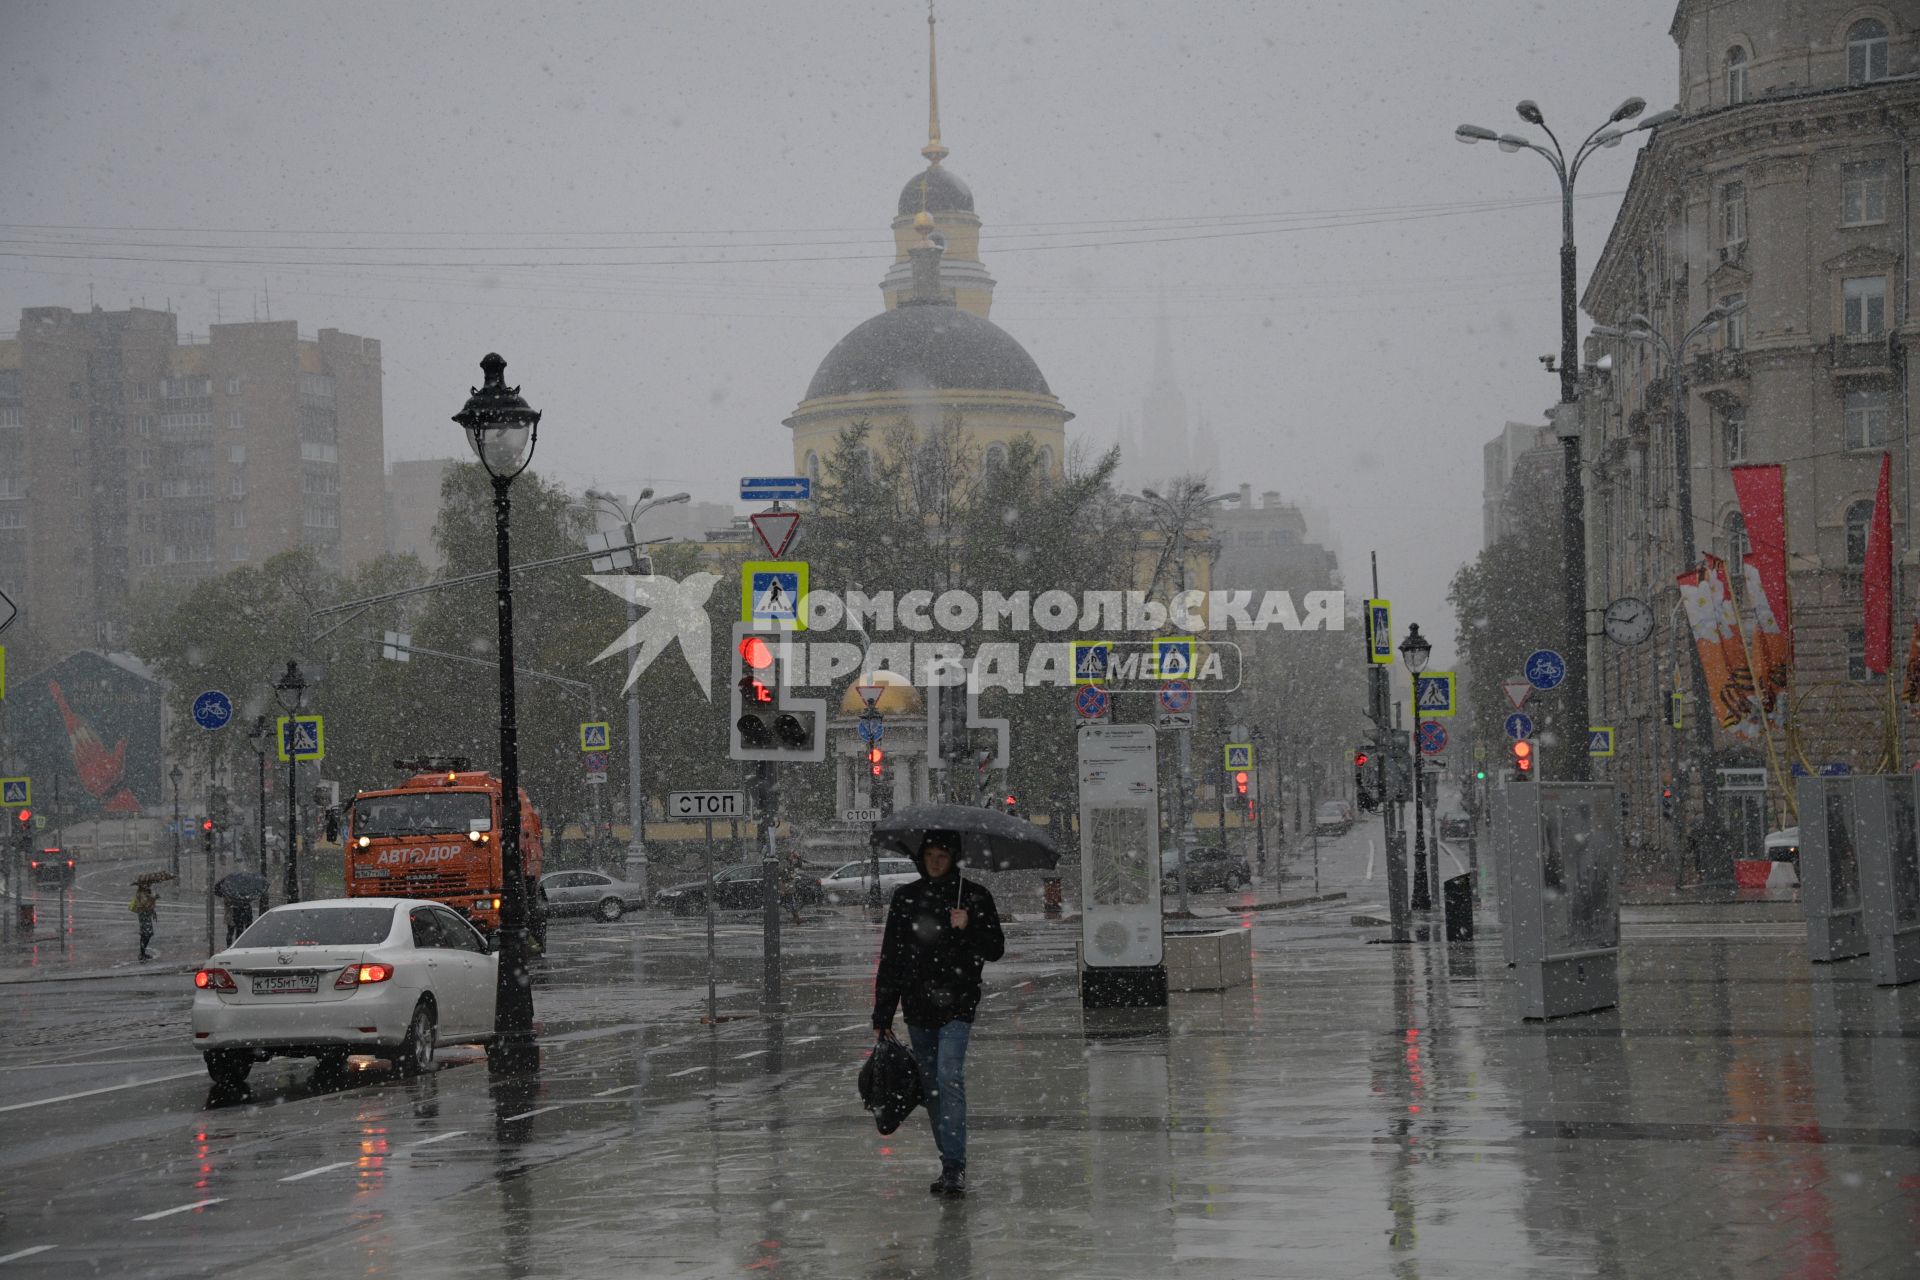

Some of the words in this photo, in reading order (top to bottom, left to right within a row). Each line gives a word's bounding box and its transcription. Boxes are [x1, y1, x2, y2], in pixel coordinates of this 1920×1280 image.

[679, 795, 735, 813] СТОП
[846, 810, 876, 820] СТОП
[376, 845, 462, 865] АВТОДОР
